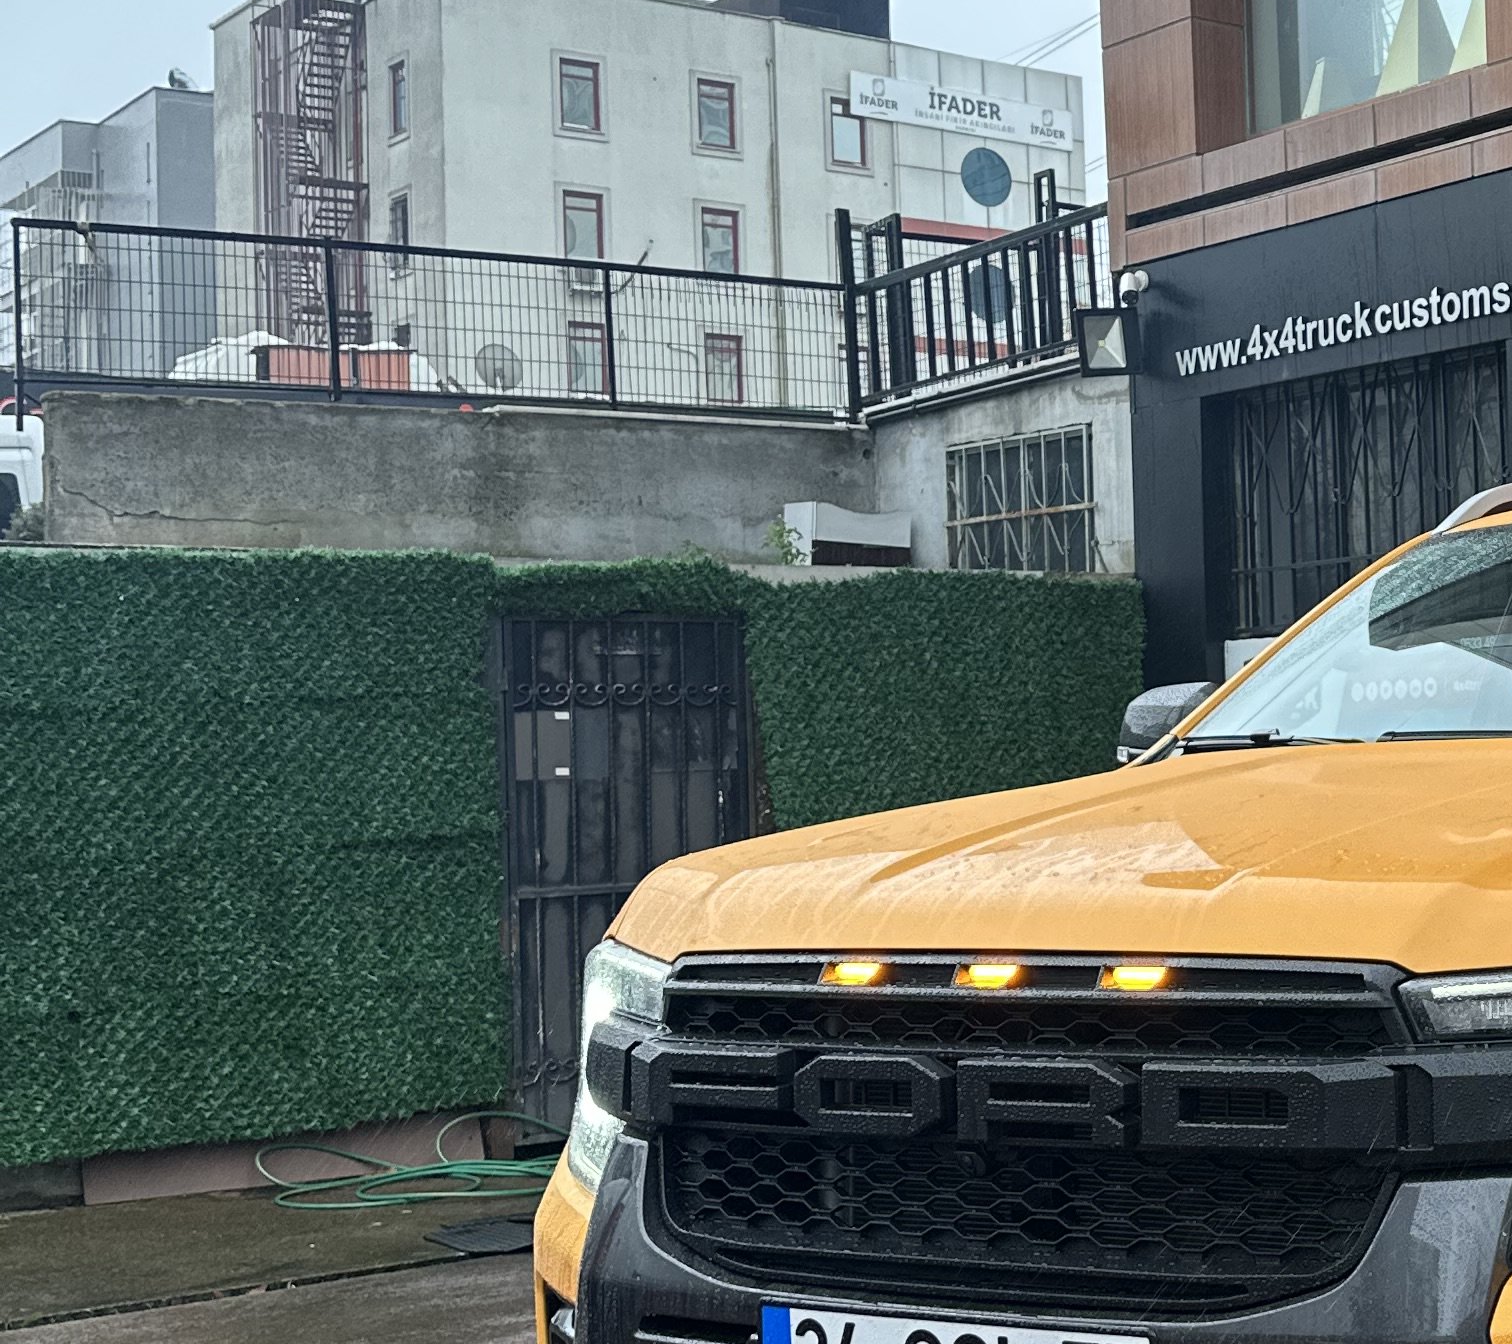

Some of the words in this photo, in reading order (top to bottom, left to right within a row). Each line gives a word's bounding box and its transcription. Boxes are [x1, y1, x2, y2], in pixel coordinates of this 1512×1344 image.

[859, 92, 898, 111] İFADER
[928, 86, 1002, 121] İFADER
[1030, 122, 1066, 140] İFADER
[632, 1036, 1398, 1152] FORD
